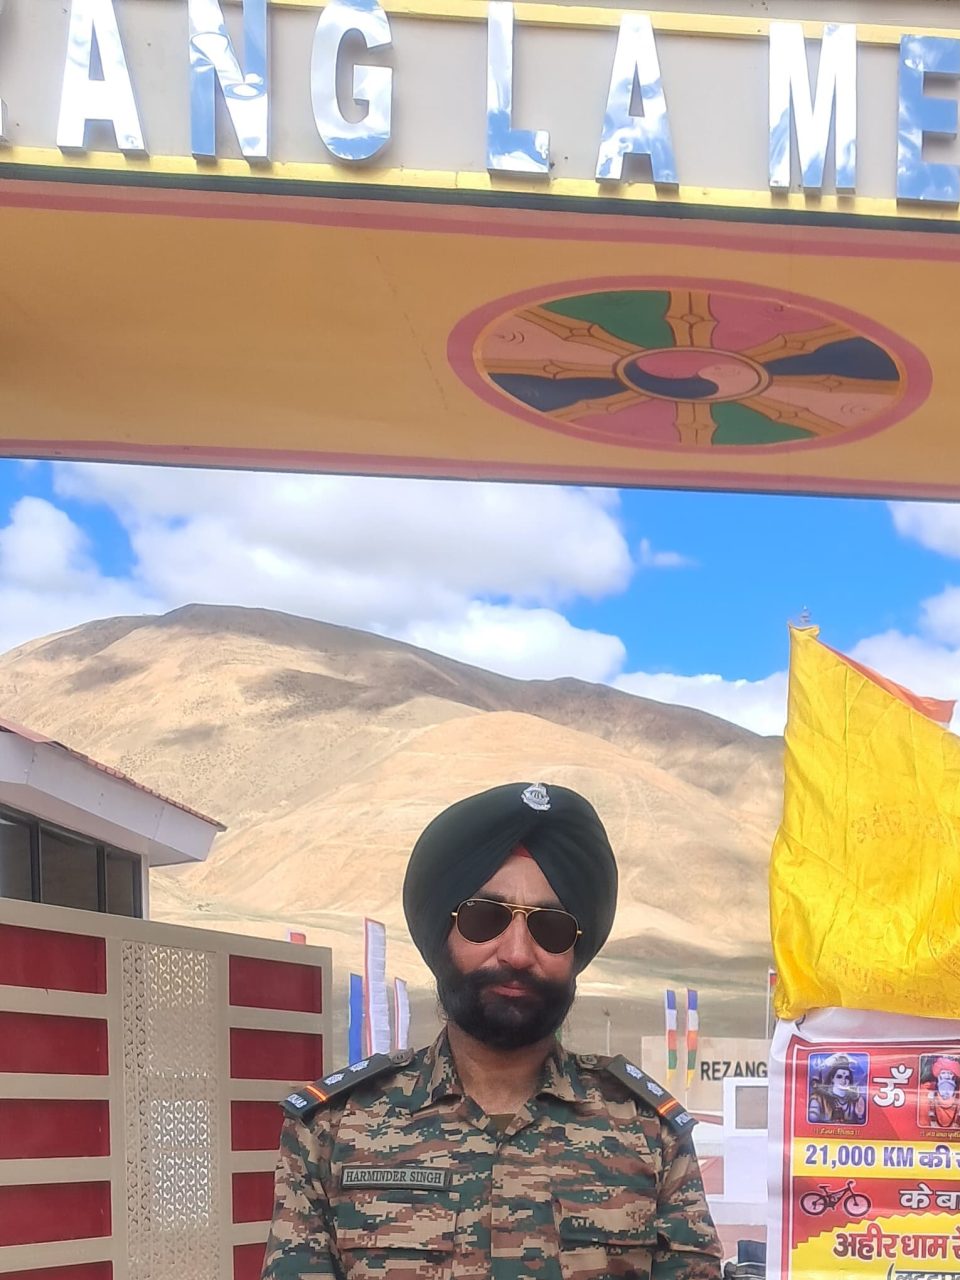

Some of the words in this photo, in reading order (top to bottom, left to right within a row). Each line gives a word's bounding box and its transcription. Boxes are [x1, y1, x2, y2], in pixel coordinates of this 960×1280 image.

[0, 0, 394, 165] ANG
[487, 0, 680, 189] LA
[701, 1060, 768, 1081] REZANG
[805, 1144, 876, 1169] 21,000
[883, 1147, 914, 1167] KM
[918, 1145, 951, 1168] की
[345, 1171, 406, 1182] HARMINDER
[409, 1173, 442, 1184] SINGH
[899, 1183, 933, 1210] के
[833, 1224, 899, 1260] अहीर
[900, 1235, 950, 1259] धाम
